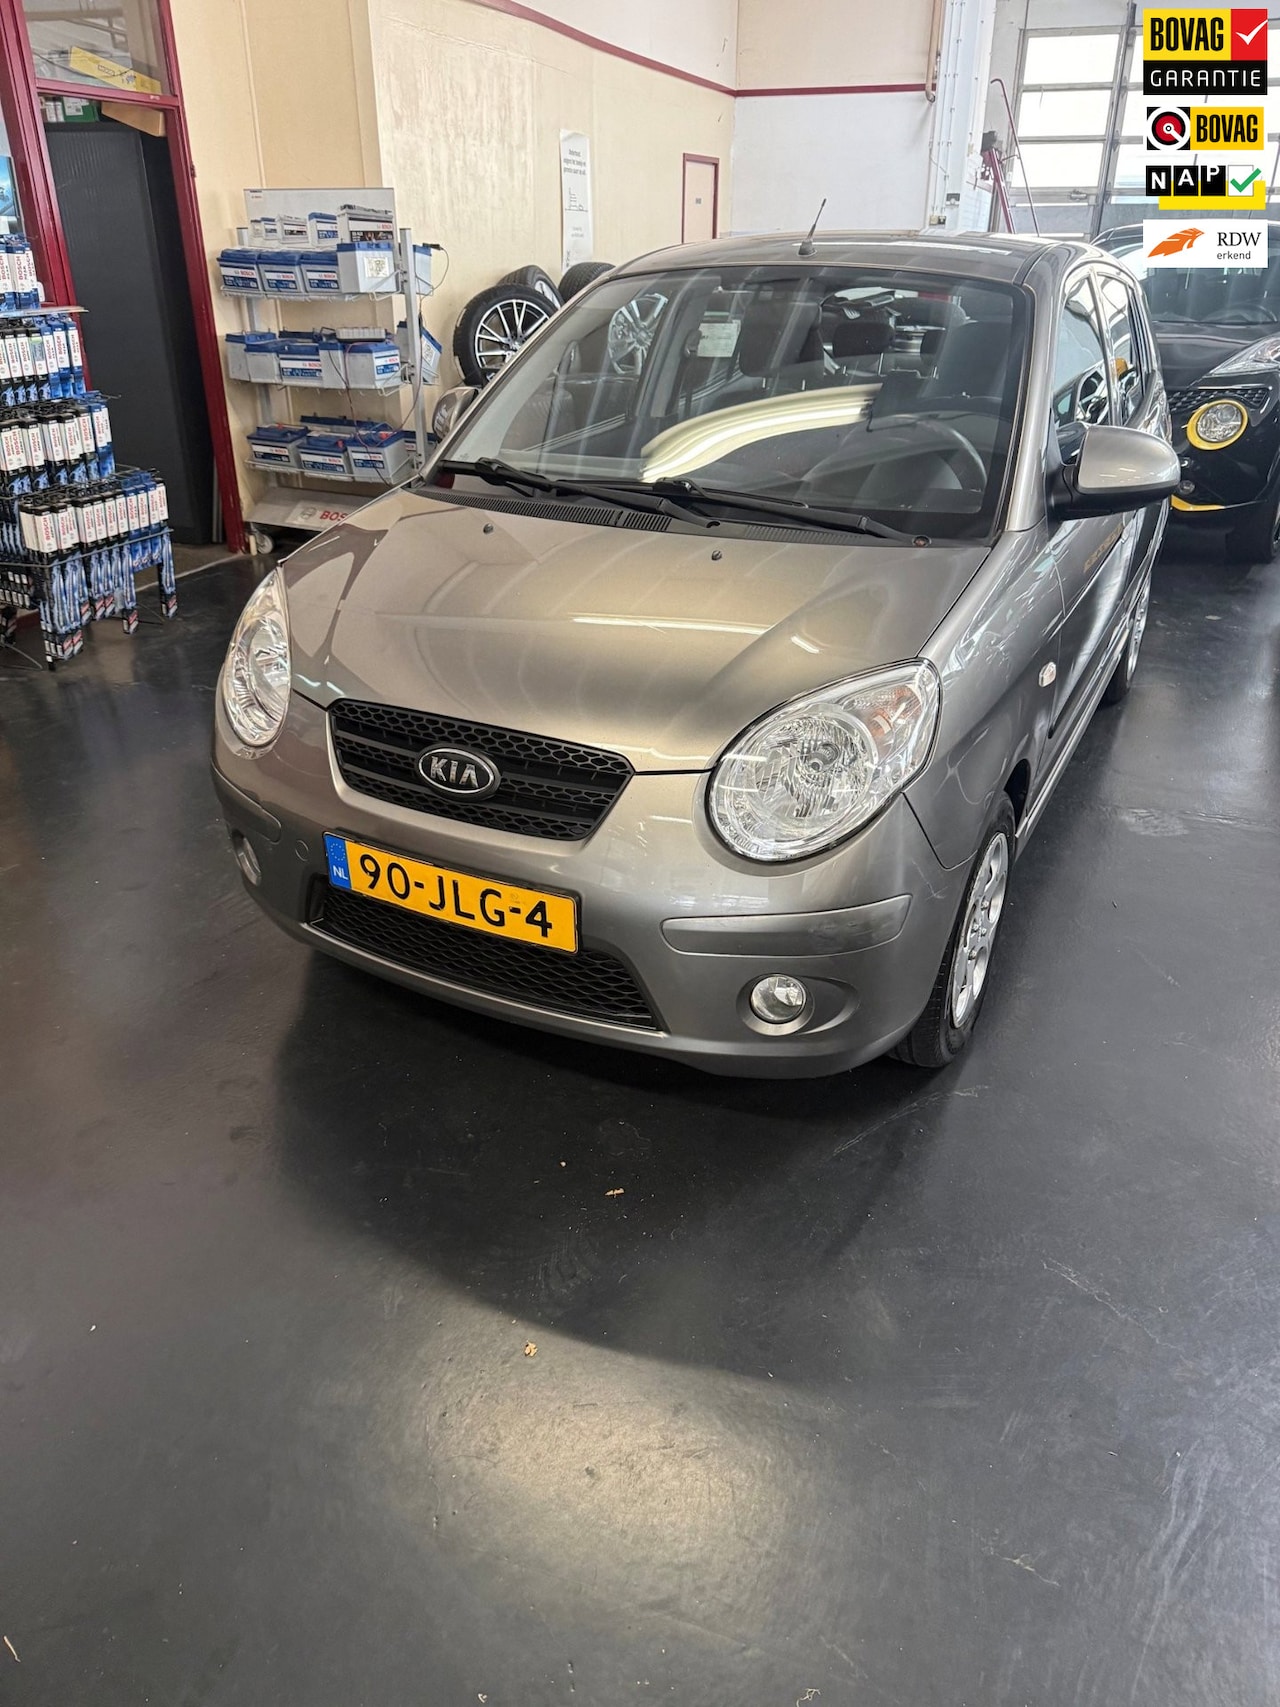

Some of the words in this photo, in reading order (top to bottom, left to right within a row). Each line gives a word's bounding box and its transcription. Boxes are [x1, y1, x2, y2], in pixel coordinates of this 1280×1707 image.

[16, 256, 24, 280] BOSCH
[320, 511, 349, 521] BOS
[430, 756, 479, 789] KIA
[333, 865, 348, 880] NL
[359, 854, 553, 938] 90-JLG-4
